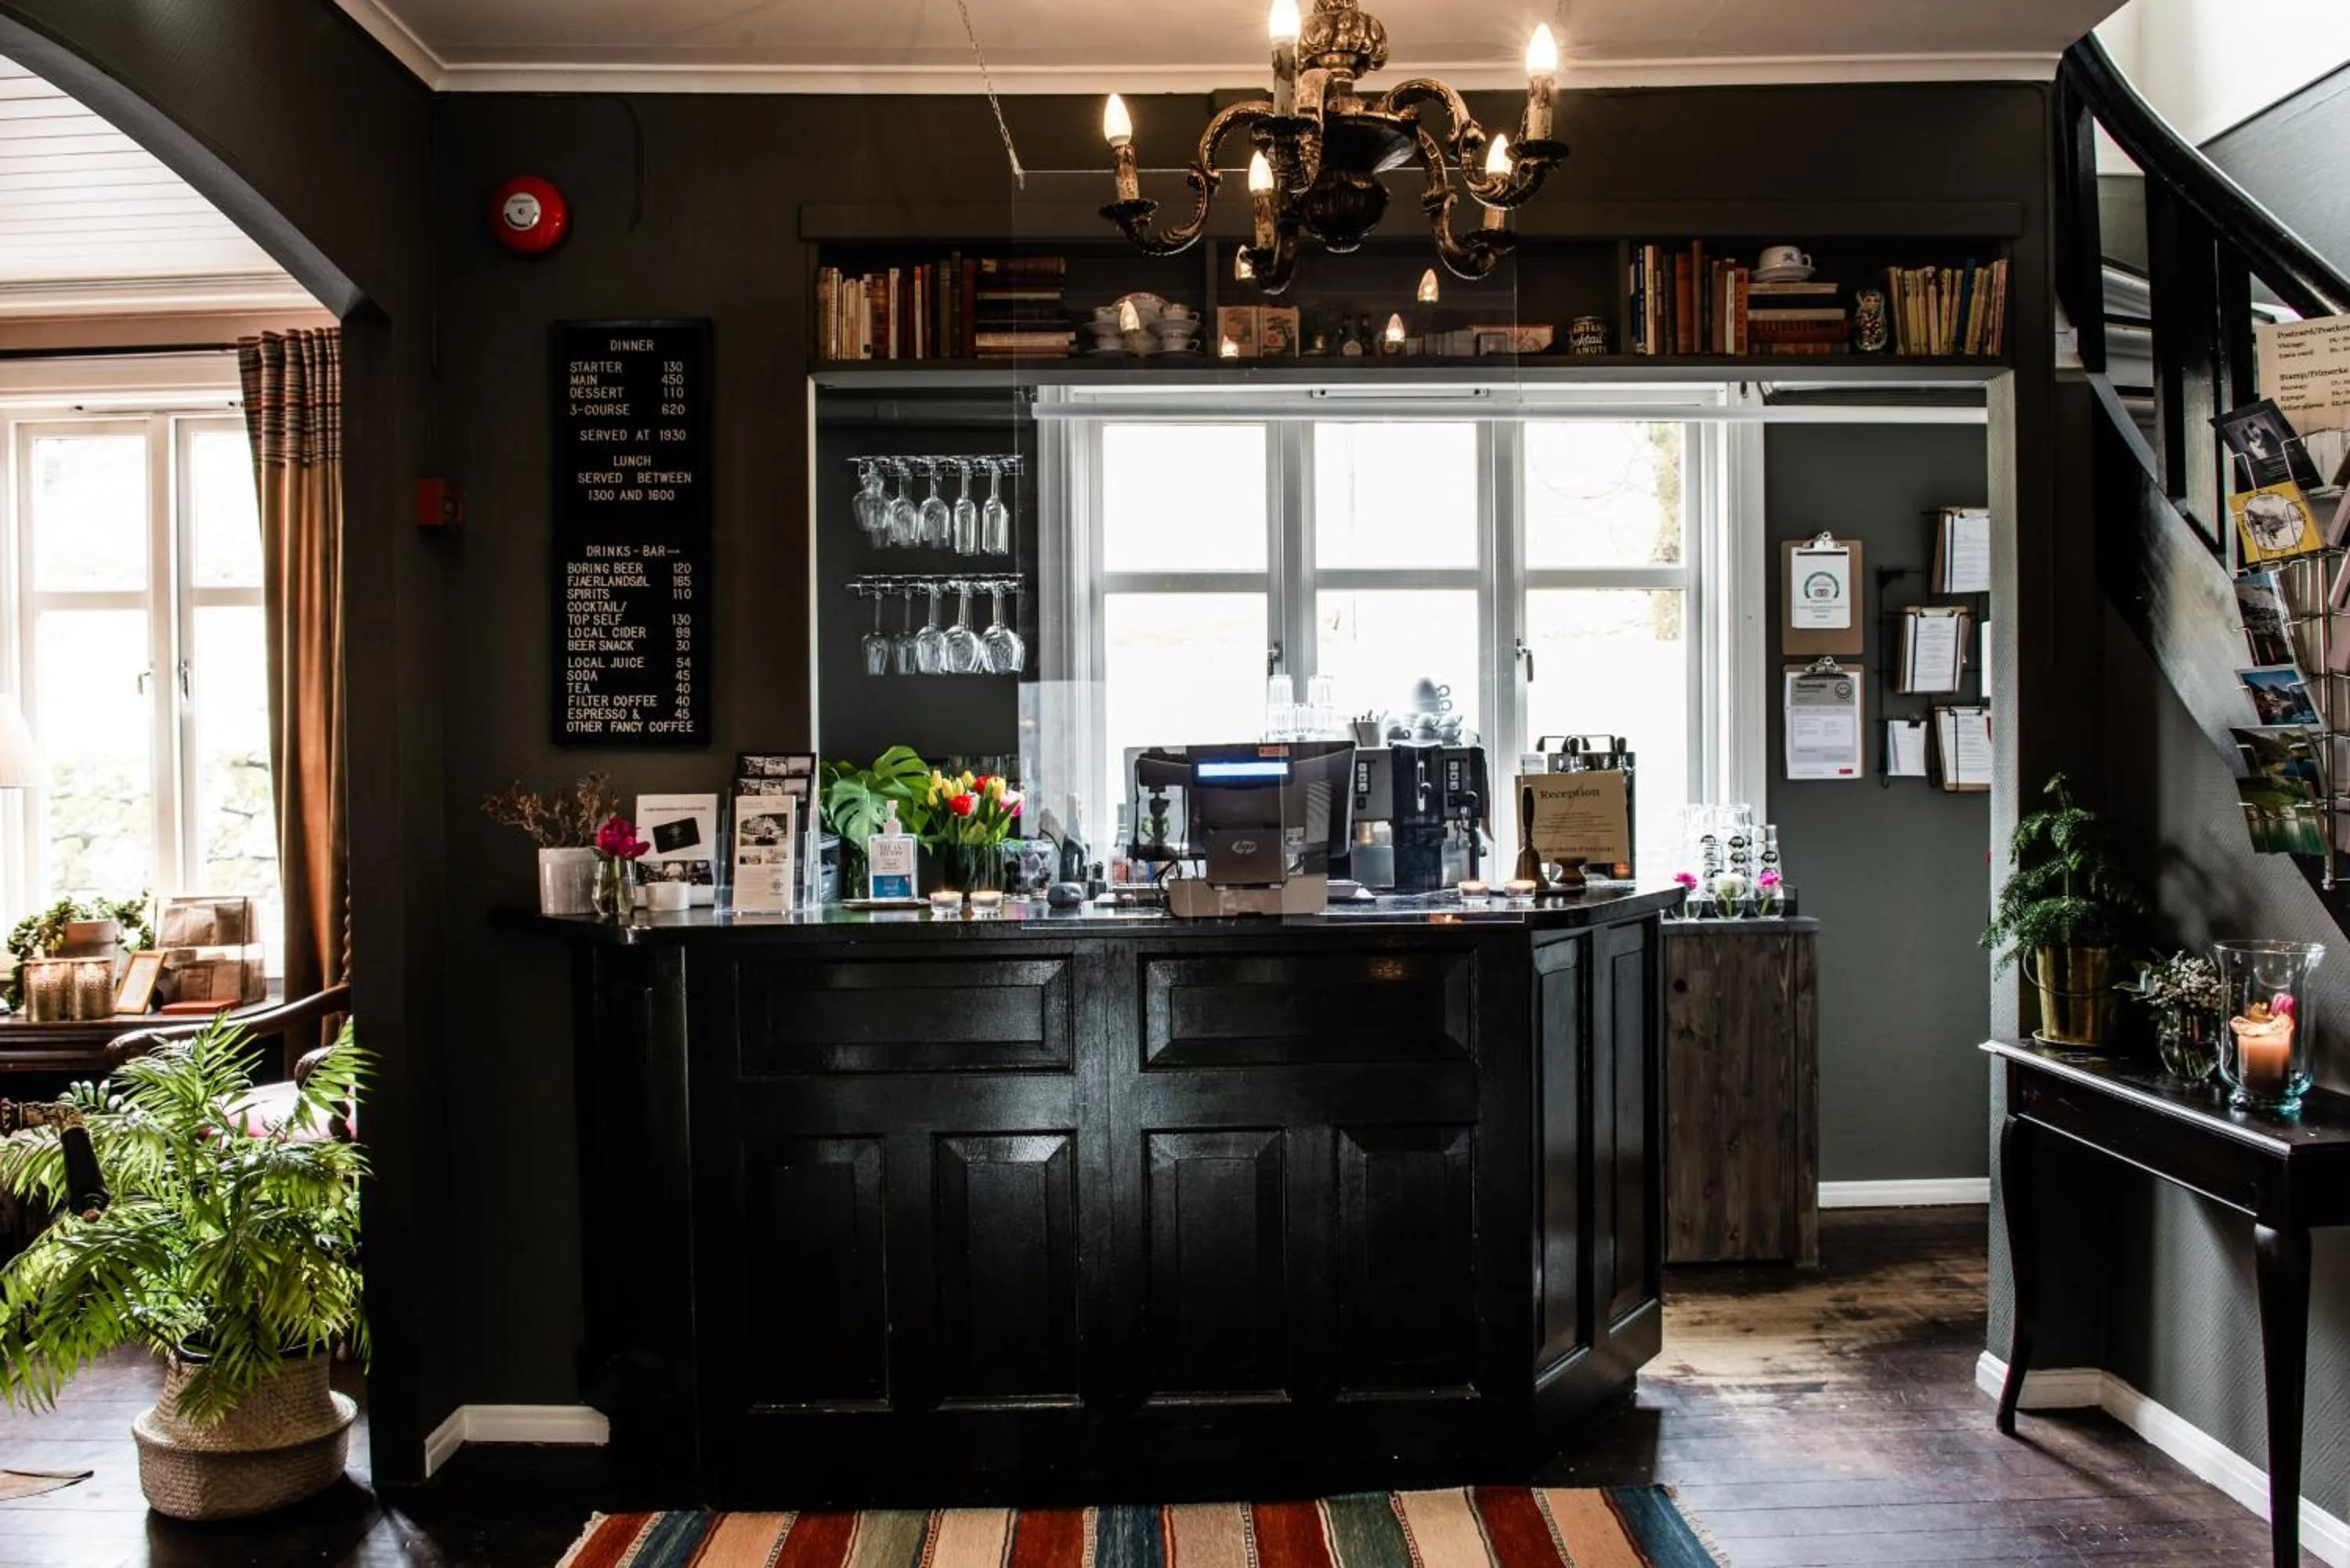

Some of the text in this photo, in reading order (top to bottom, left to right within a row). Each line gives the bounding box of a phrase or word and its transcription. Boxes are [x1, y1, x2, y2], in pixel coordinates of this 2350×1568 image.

[610, 339, 654, 352] DINNER
[569, 361, 683, 374] STARTER 130
[569, 374, 684, 385] MAIN 450
[569, 386, 684, 399] DESSERT 110
[569, 403, 685, 416] 3-COURSE 620
[580, 429, 627, 441] SERVED
[635, 429, 649, 441] AT
[613, 455, 651, 467] LUNCH
[577, 471, 692, 483] SERVED BETWEEN
[588, 489, 615, 500] 1300
[619, 489, 643, 500] AND
[567, 562, 692, 574] BORING BEER 120
[566, 588, 692, 600] SPIRITS 110
[566, 601, 627, 612] COCKTAIL/
[567, 614, 692, 626] TOP SELF 130
[567, 627, 607, 638] LOCAL
[612, 627, 647, 638] CIDER
[567, 639, 690, 652] BEER SNACK 30
[567, 656, 691, 668] LOCAL JUICE 54
[566, 670, 690, 681] SODA 45
[566, 682, 691, 694] TEA 40
[568, 695, 690, 707] FILTER COFFEE 40
[567, 708, 690, 720] ESPRESSO & 45
[566, 721, 694, 732] OTHER FANCY COFFEE
[1539, 788, 1600, 799] Reception
